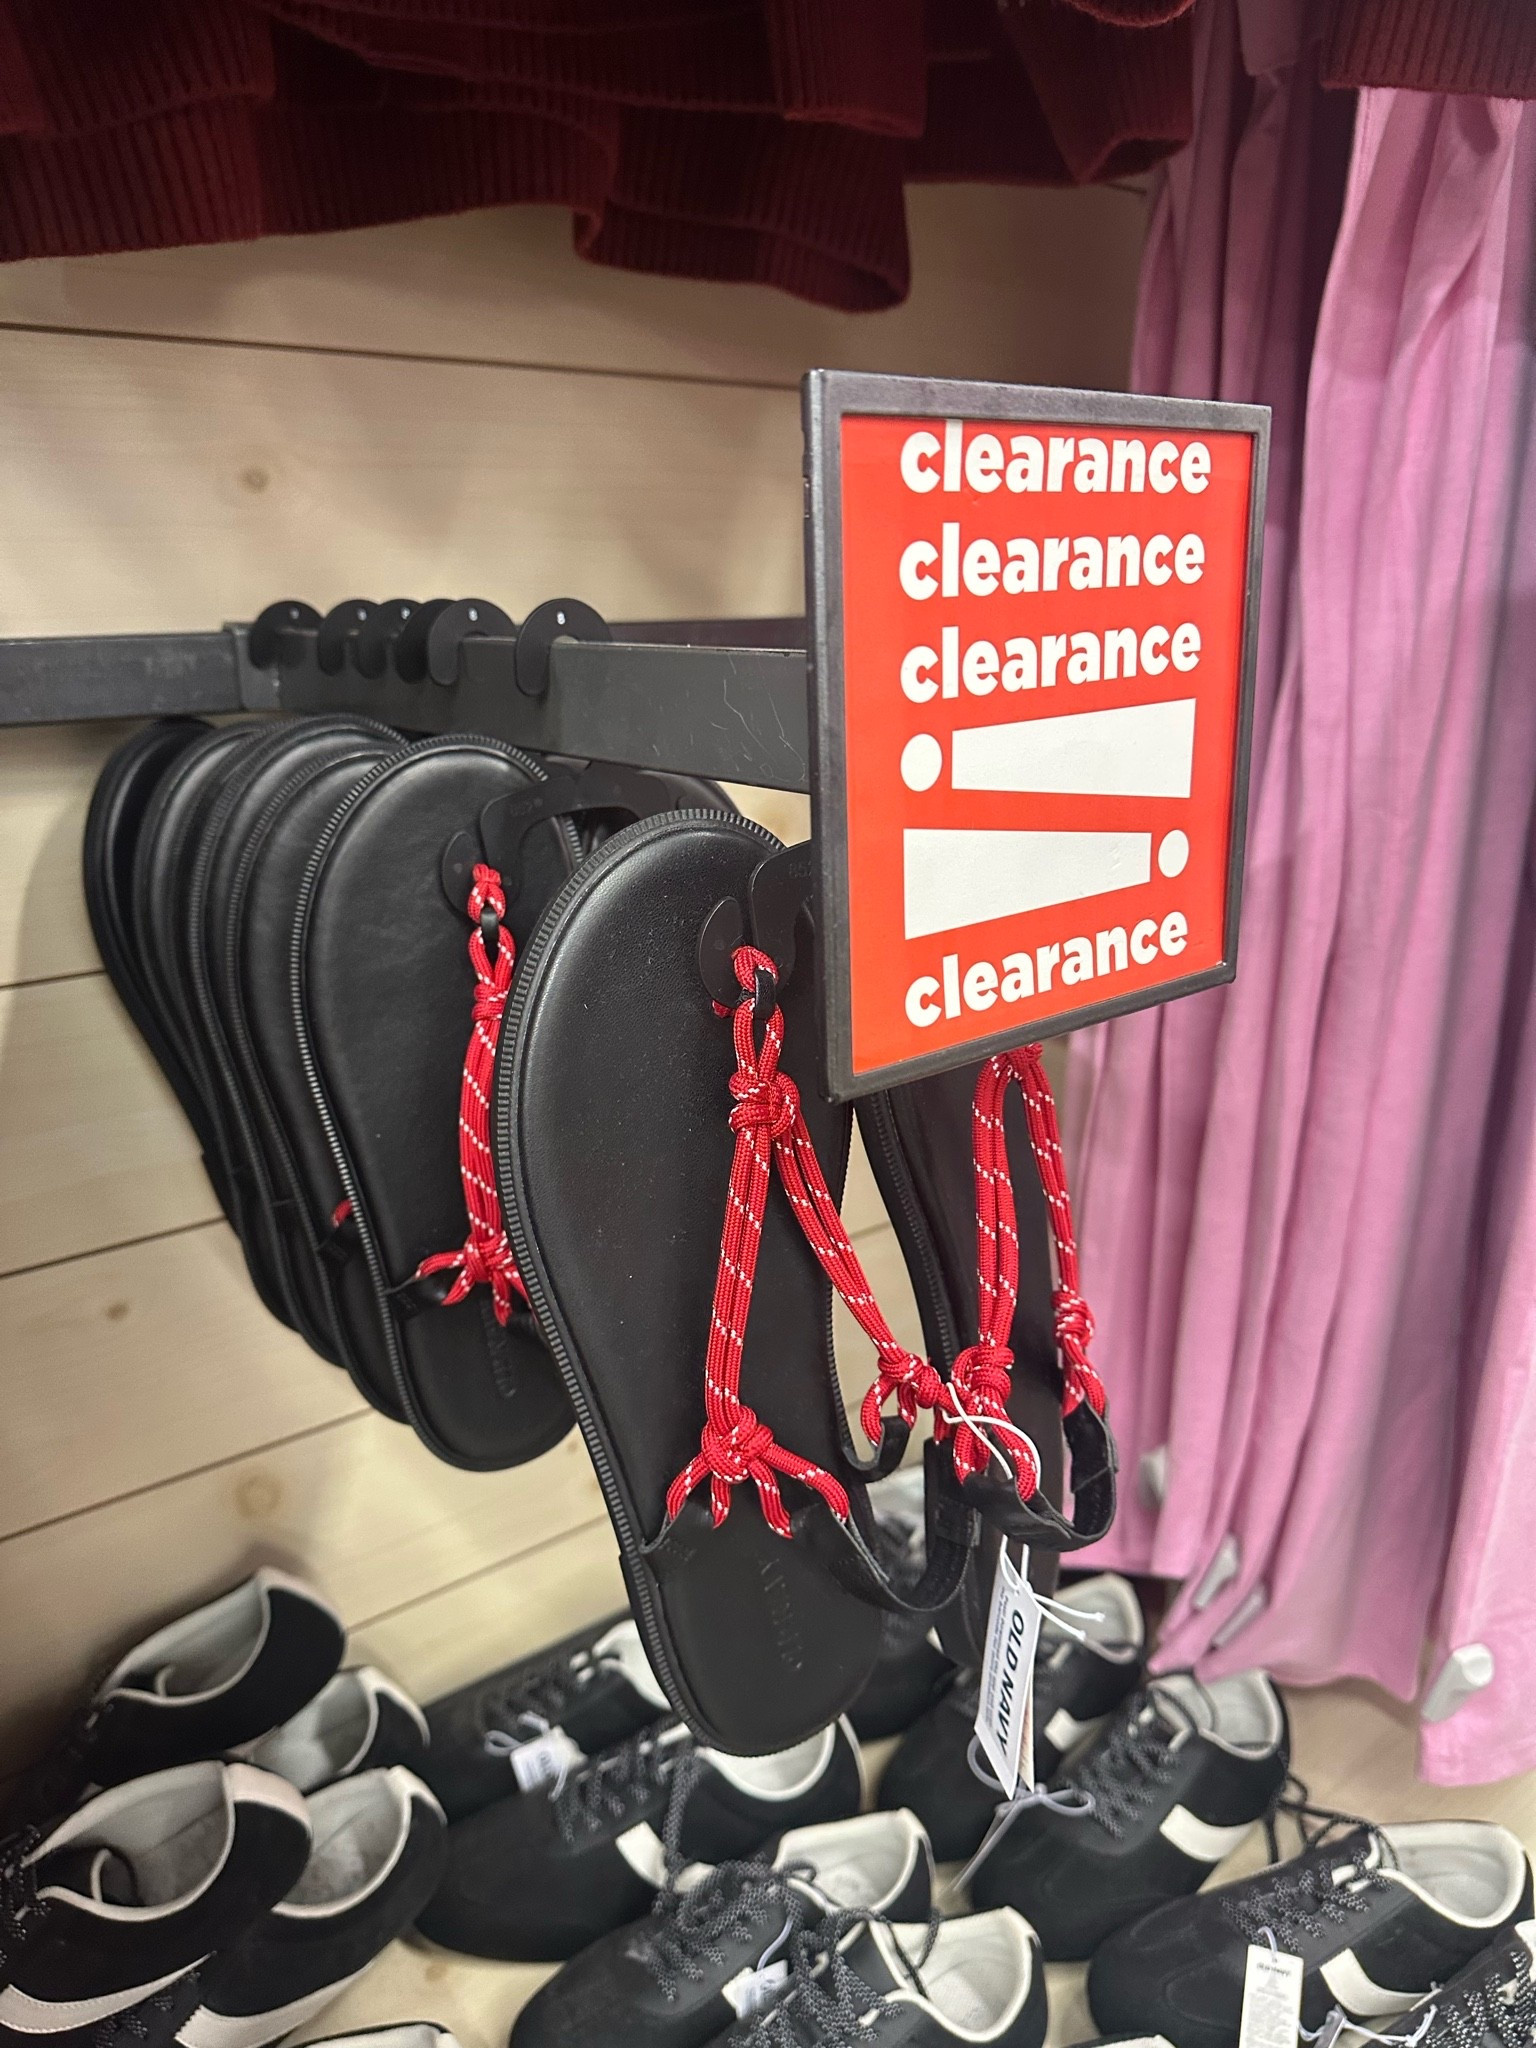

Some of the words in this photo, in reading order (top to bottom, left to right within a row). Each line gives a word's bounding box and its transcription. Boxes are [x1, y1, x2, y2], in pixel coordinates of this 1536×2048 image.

[900, 419, 1212, 494] clearance
[898, 522, 1205, 601] clearance
[899, 622, 1202, 704] clearance
[904, 911, 1189, 1028] clearance
[1006, 1609, 1025, 1671] OLD
[996, 1668, 1014, 1757] NAVY
